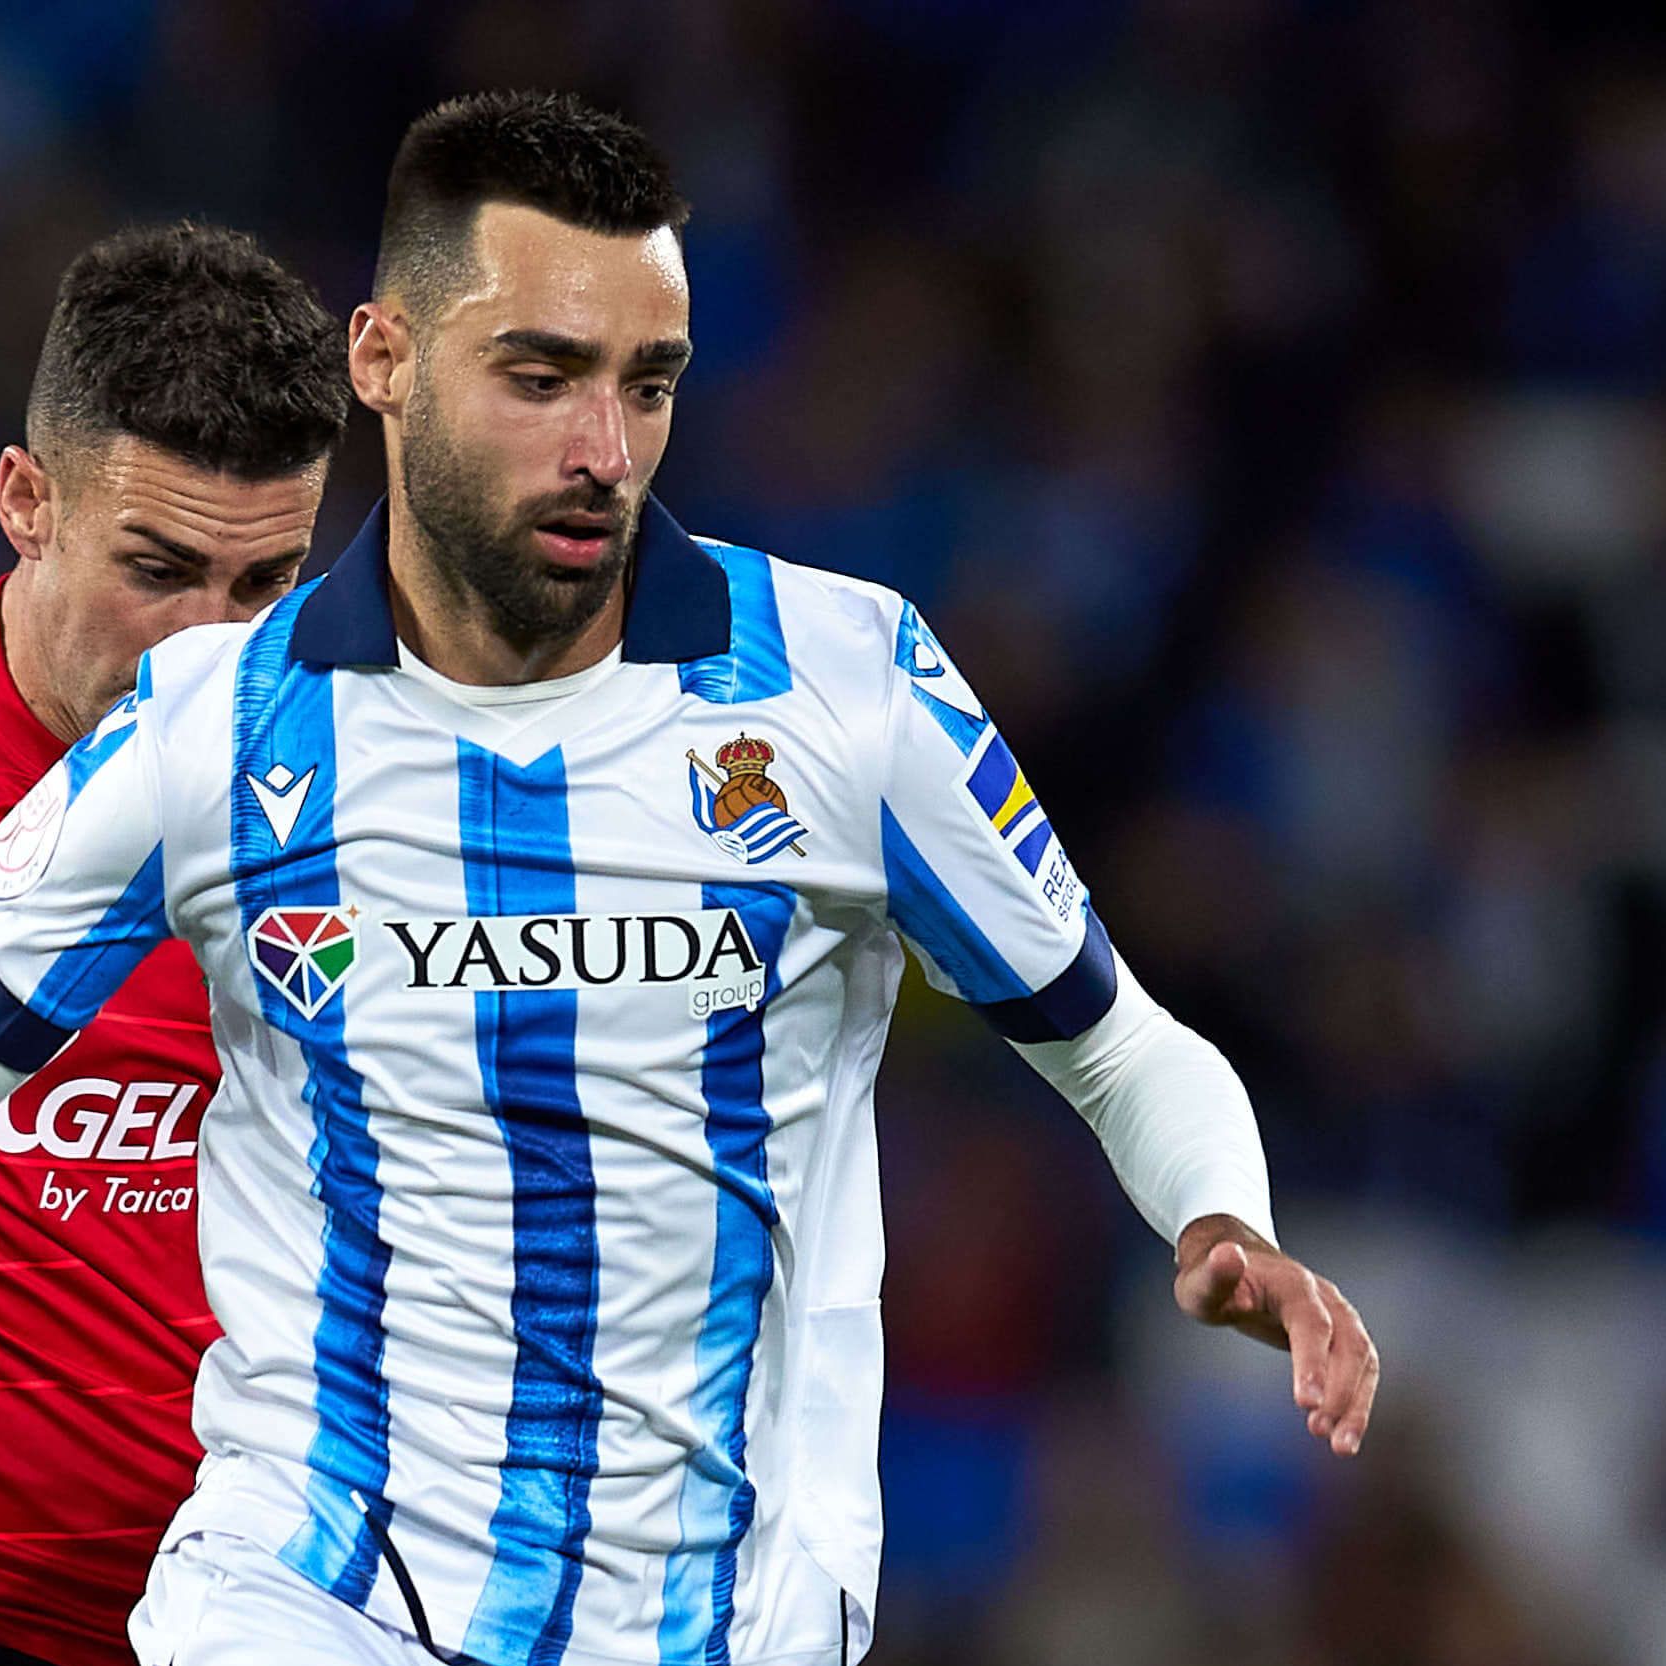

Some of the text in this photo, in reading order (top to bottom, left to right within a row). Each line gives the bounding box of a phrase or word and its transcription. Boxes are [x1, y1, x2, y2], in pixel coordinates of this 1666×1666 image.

[382, 911, 764, 988] YASUDA
[693, 979, 762, 1016] group
[39, 1171, 194, 1222] by Taica
